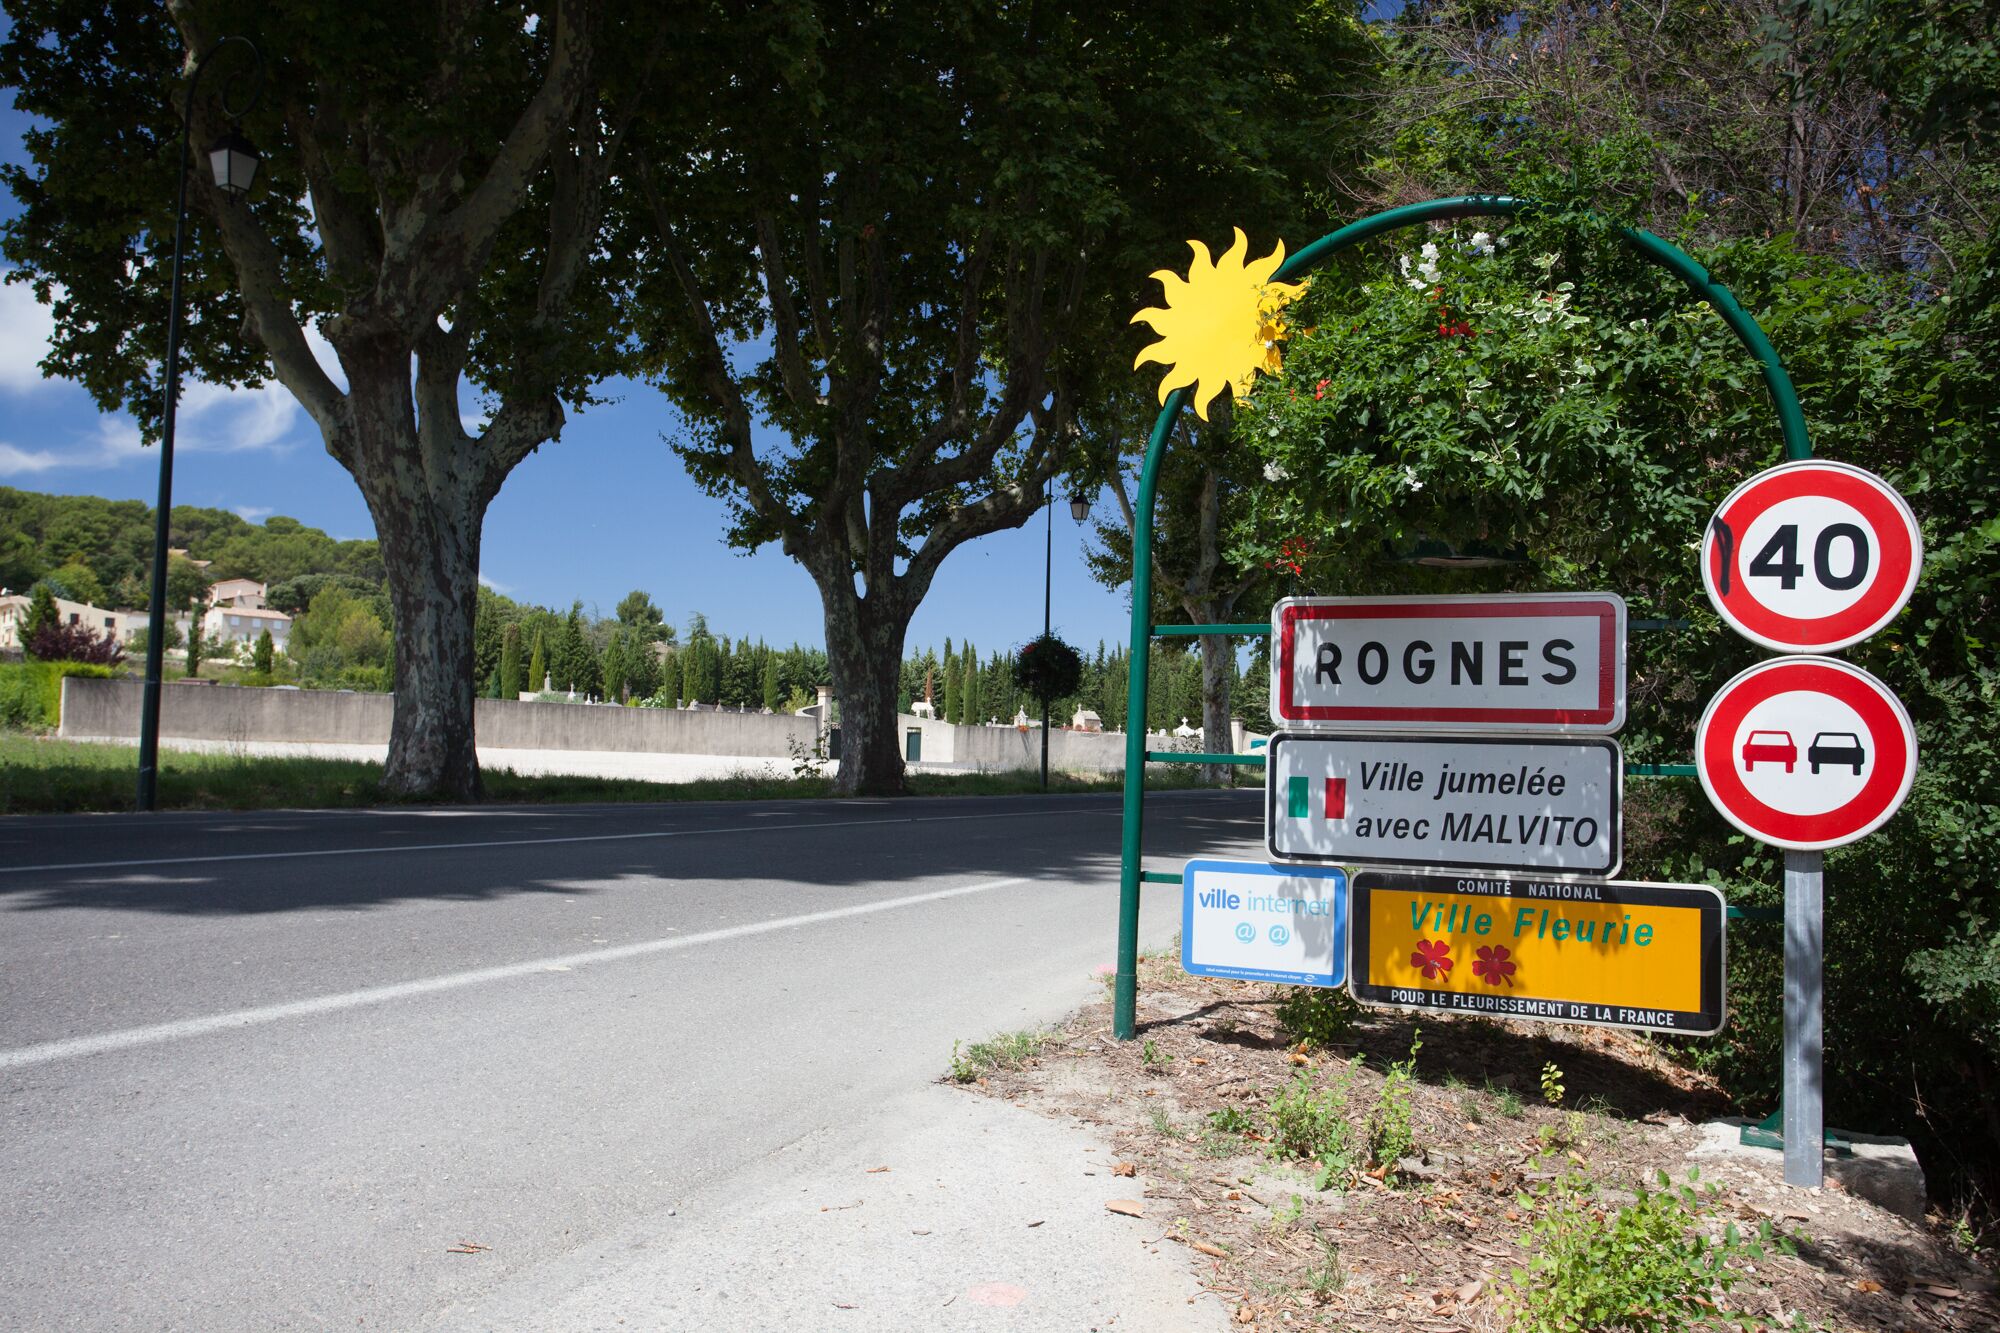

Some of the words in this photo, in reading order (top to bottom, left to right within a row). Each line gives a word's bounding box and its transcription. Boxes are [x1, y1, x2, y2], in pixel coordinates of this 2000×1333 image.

[1749, 523, 1869, 591] 40
[1315, 639, 1577, 686] ROGNES
[1360, 762, 1424, 792] Ville
[1433, 763, 1566, 800] jumelée
[1355, 816, 1430, 840] avec
[1440, 812, 1598, 848] MALVITO
[1199, 888, 1240, 910] ville
[1247, 890, 1330, 917] internet
[1457, 879, 1512, 895] COMITÉ
[1528, 883, 1602, 900] NATIONAL
[1411, 901, 1493, 936] Ville
[1513, 908, 1654, 947] Fleurie
[1391, 989, 1425, 1004] POUR
[1431, 993, 1447, 1006] LE
[1453, 994, 1563, 1016] FLEURISSEMENT
[1570, 1004, 1588, 1018] DE
[1595, 1007, 1612, 1020] LA
[1619, 1009, 1675, 1026] FRANCE
